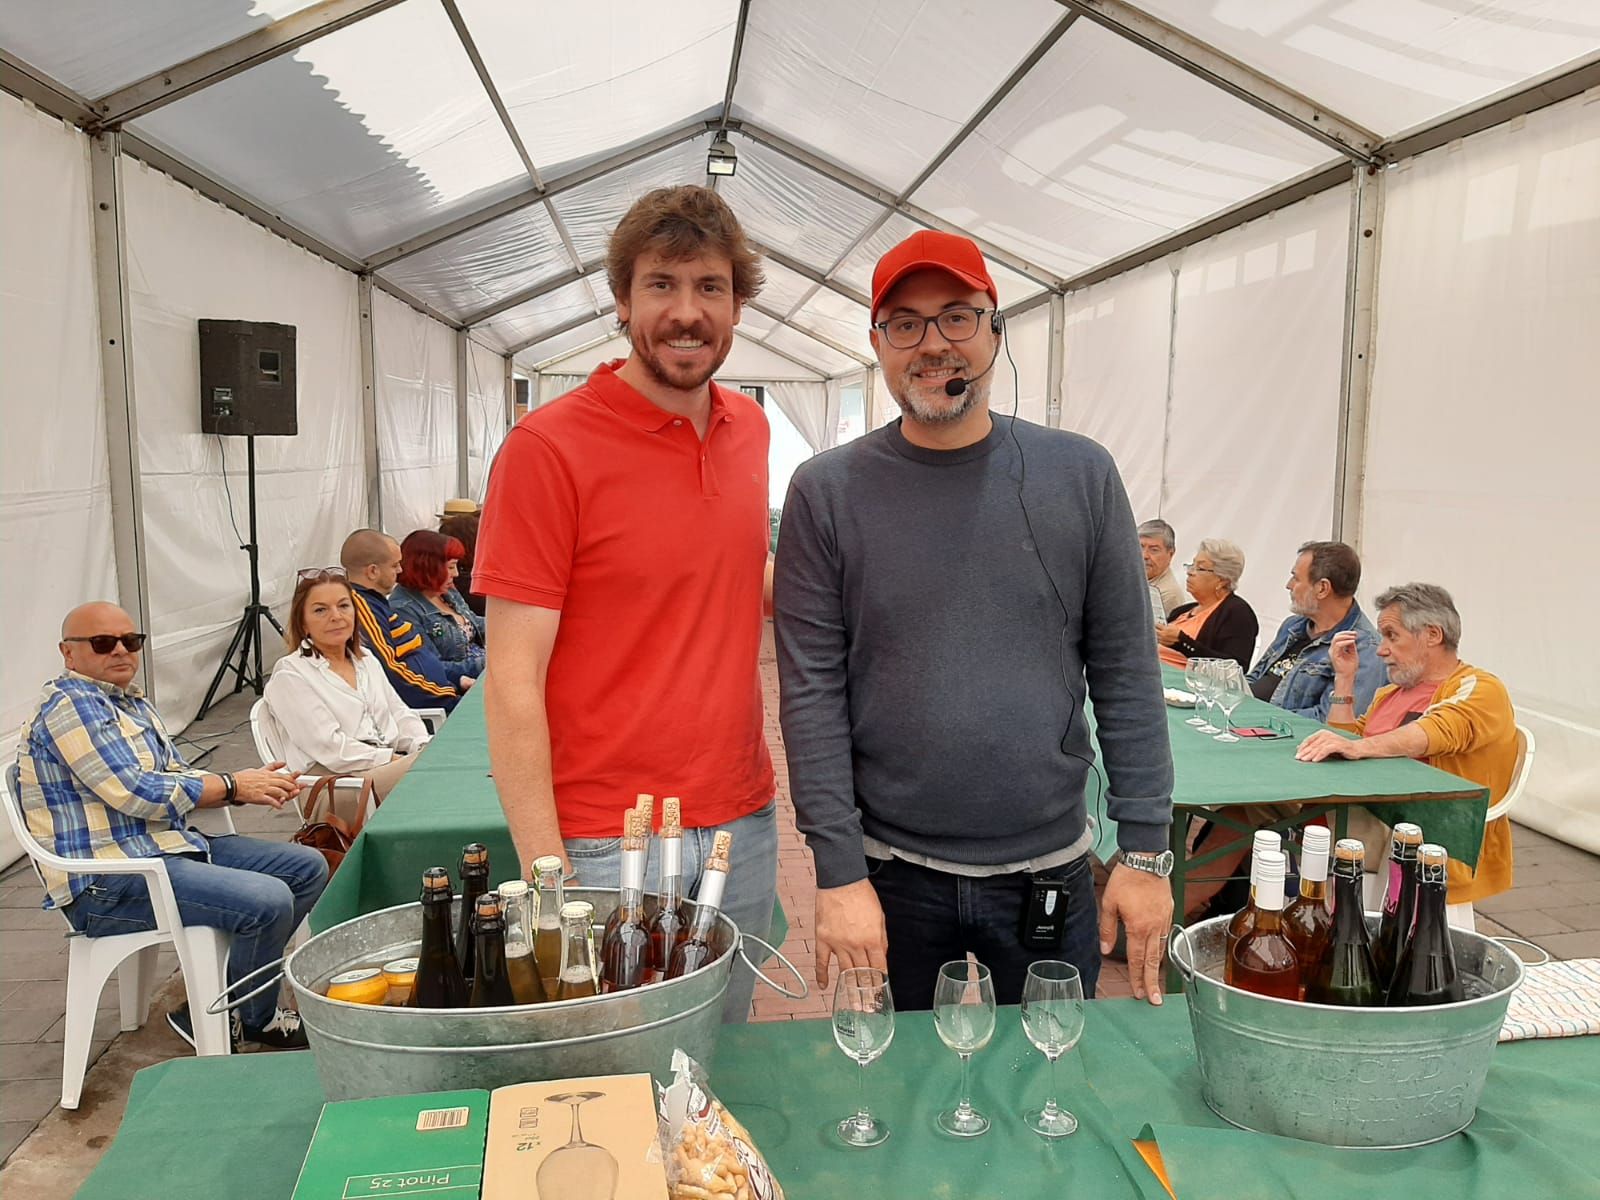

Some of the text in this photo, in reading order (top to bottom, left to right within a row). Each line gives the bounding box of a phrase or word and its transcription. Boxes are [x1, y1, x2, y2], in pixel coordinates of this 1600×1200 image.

[1317, 1053, 1444, 1084] COLD
[369, 1173, 450, 1189] Pinot 25
